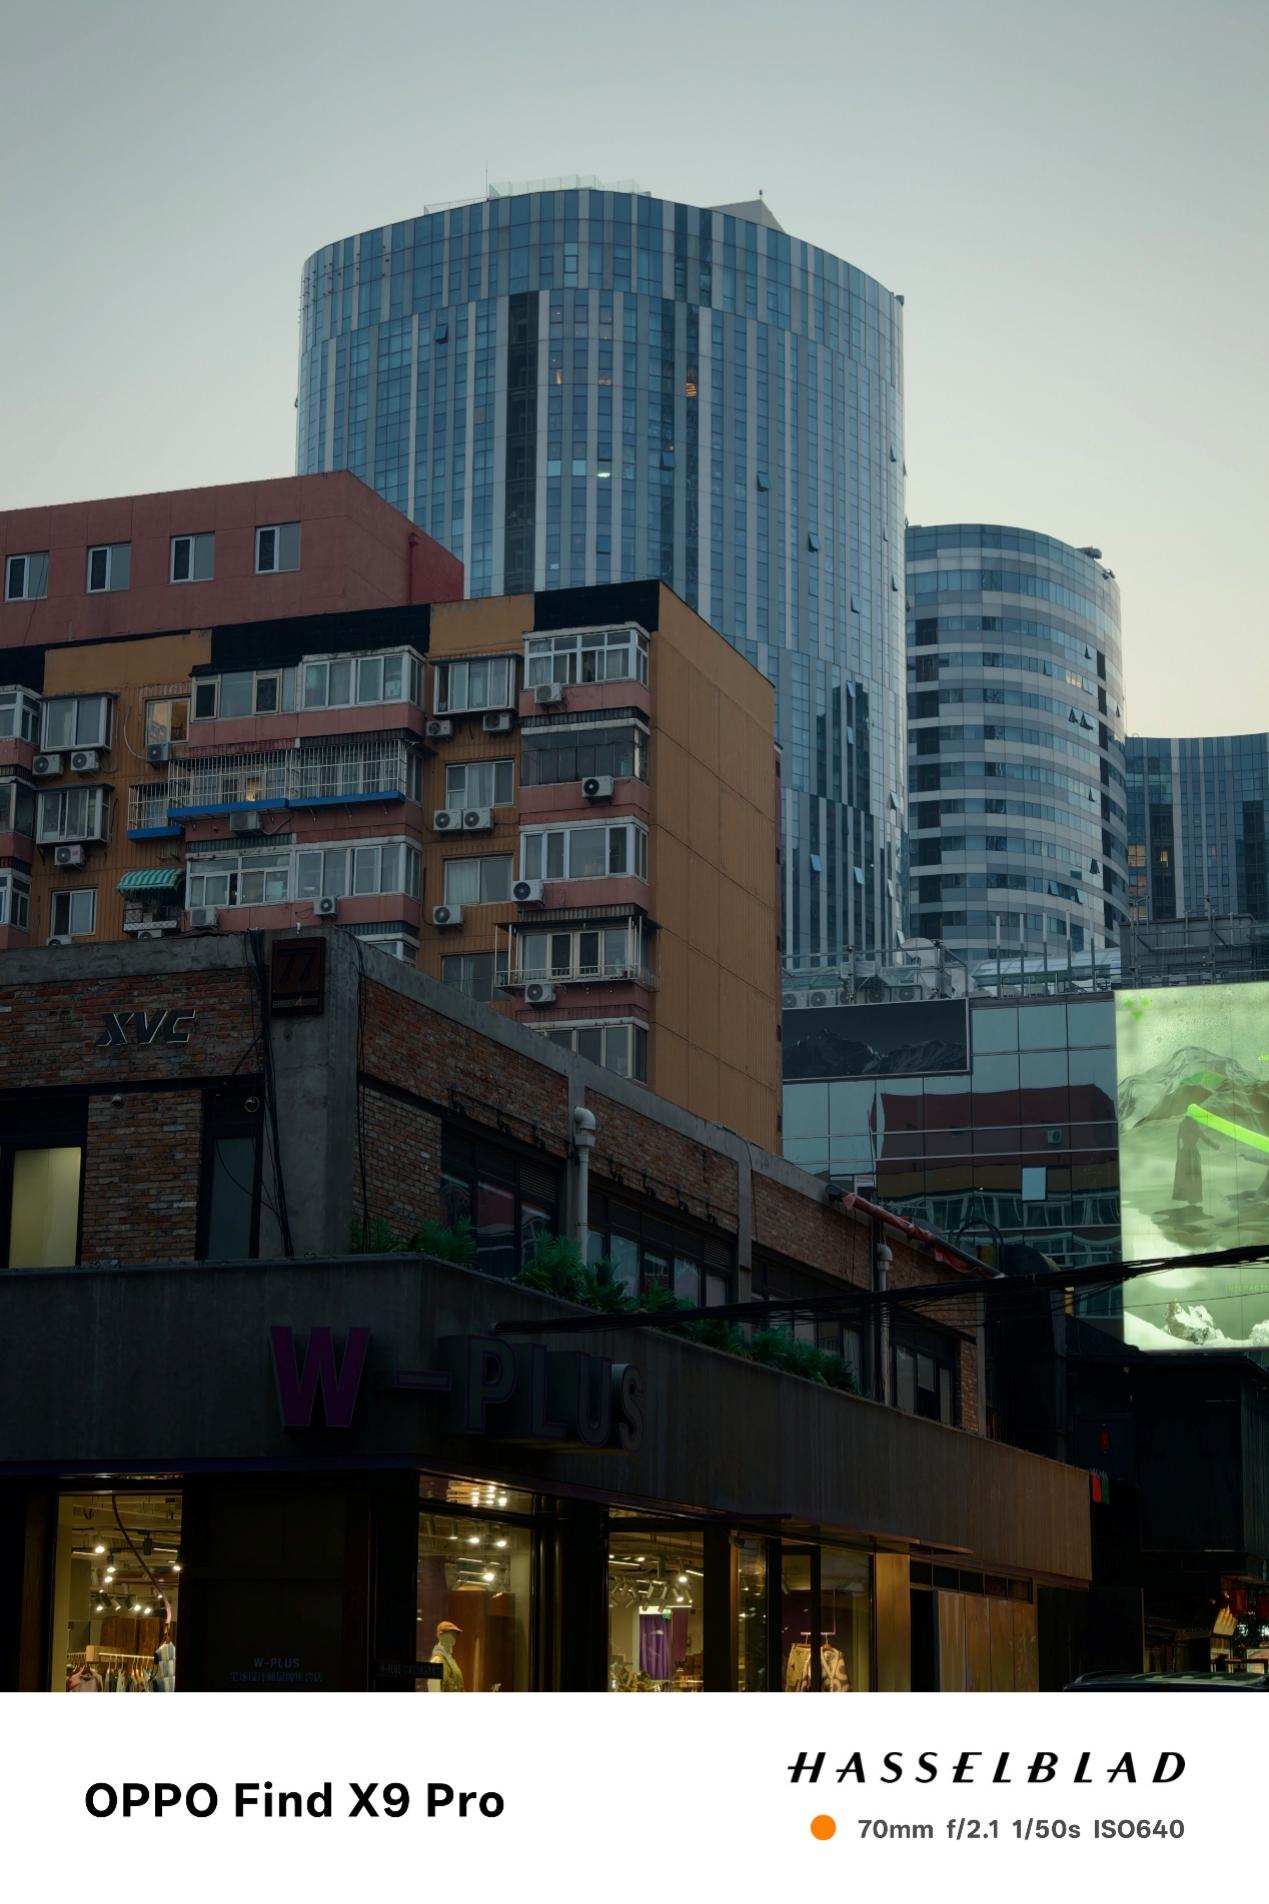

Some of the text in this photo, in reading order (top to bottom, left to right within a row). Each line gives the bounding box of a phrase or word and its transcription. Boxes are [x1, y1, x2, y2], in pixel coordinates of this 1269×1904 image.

[96, 1009, 195, 1046] XVC
[270, 1326, 644, 1455] W-PLUS
[253, 1657, 300, 1669] W-PLUS
